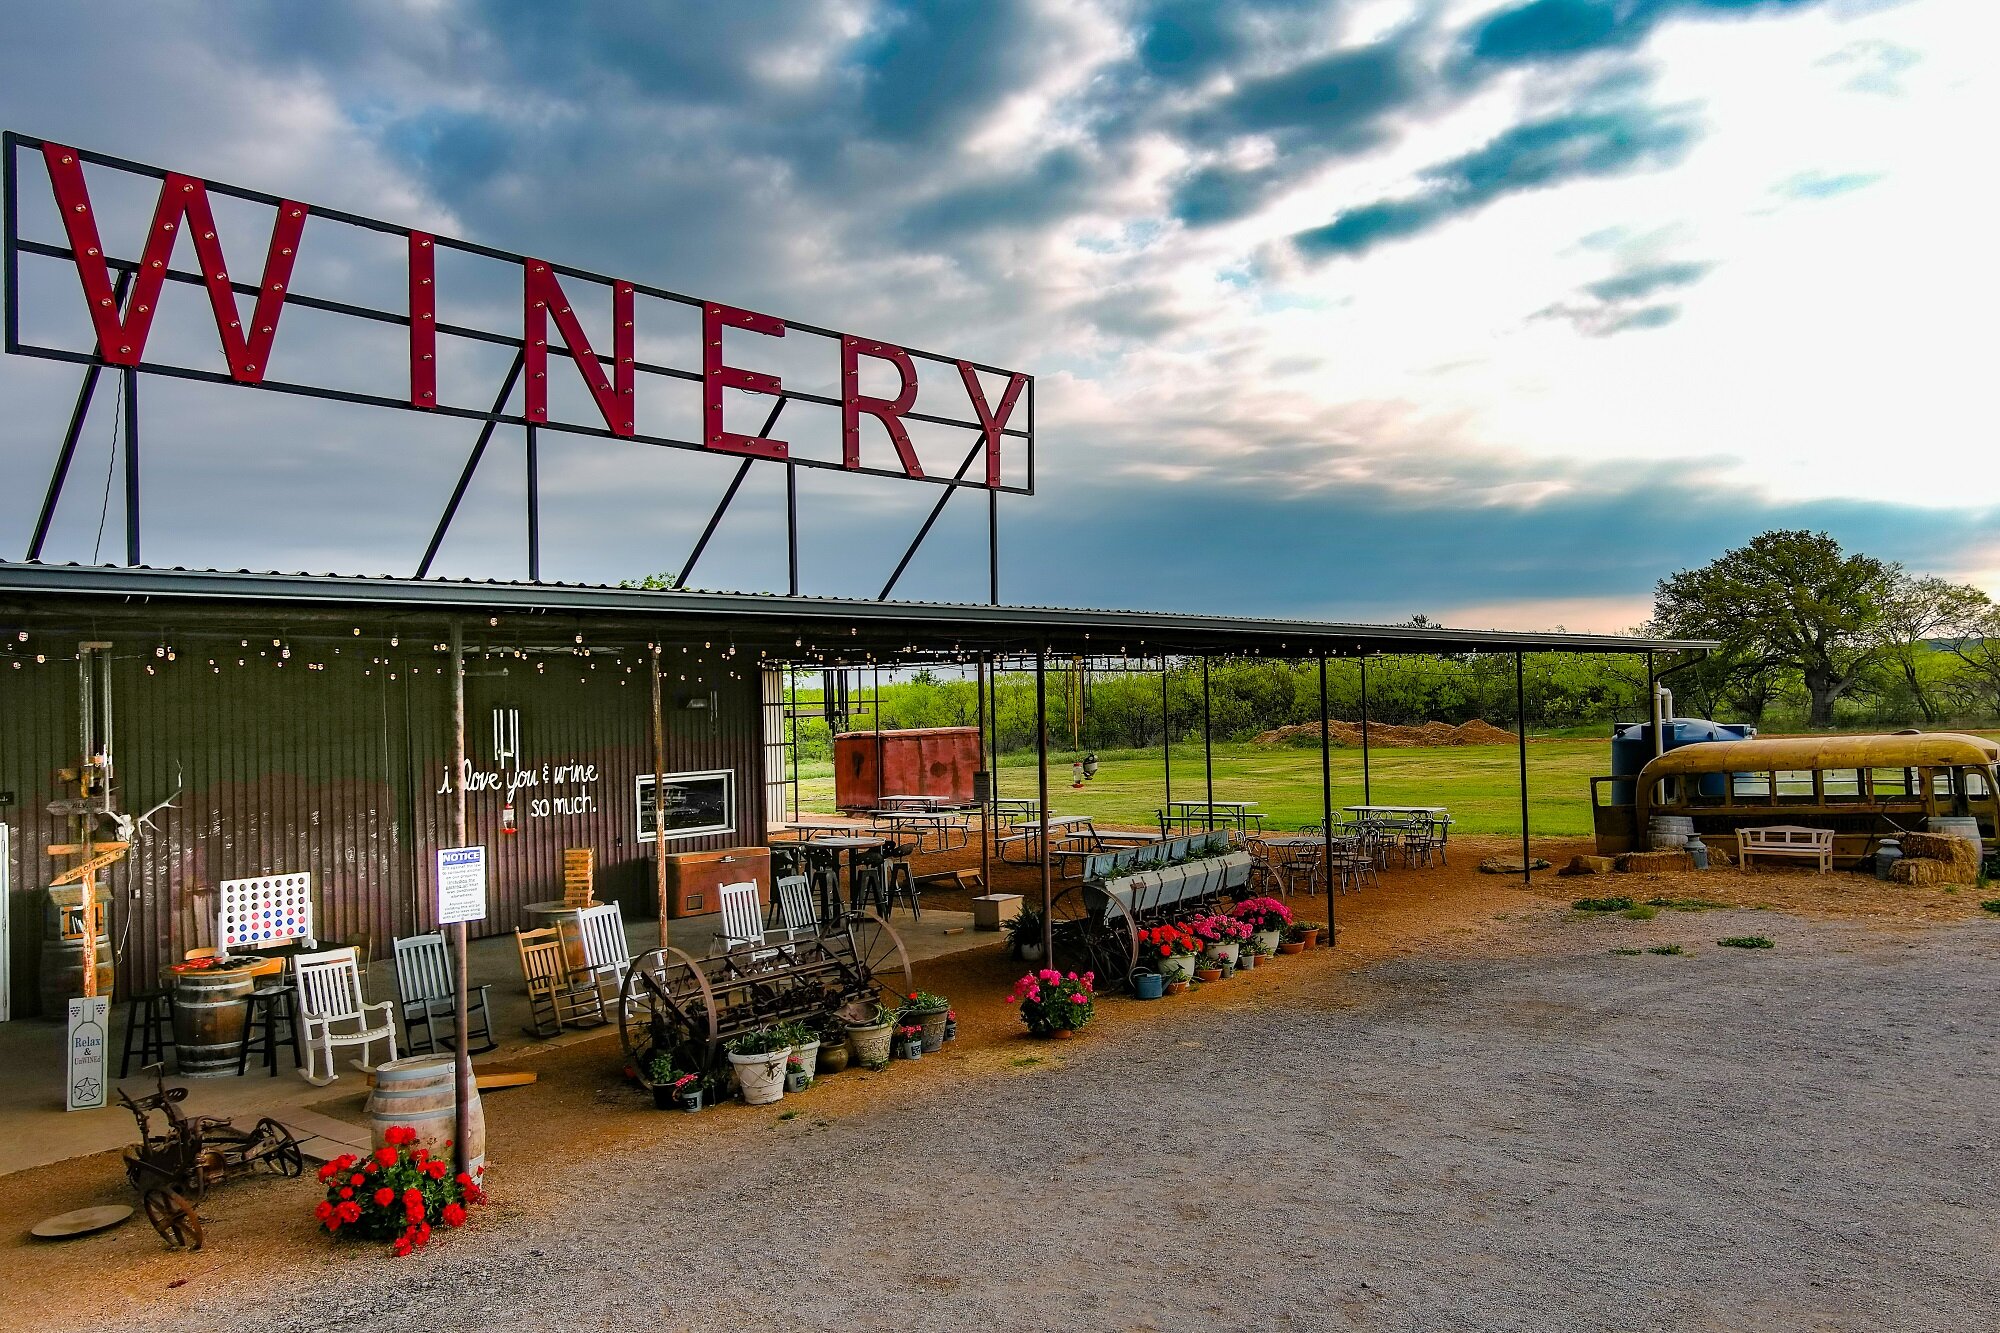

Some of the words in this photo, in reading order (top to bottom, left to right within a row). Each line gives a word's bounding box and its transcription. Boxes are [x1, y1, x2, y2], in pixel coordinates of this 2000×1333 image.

[41, 141, 1028, 488] WINERY
[437, 765, 453, 794] i
[464, 758, 503, 792] love
[506, 768, 539, 803] you
[554, 758, 599, 785] wine
[530, 798, 550, 818] so
[553, 785, 597, 816] much.
[92, 855, 111, 868] Texas
[443, 851, 480, 862] NOTICE
[75, 1036, 100, 1047] Relax
